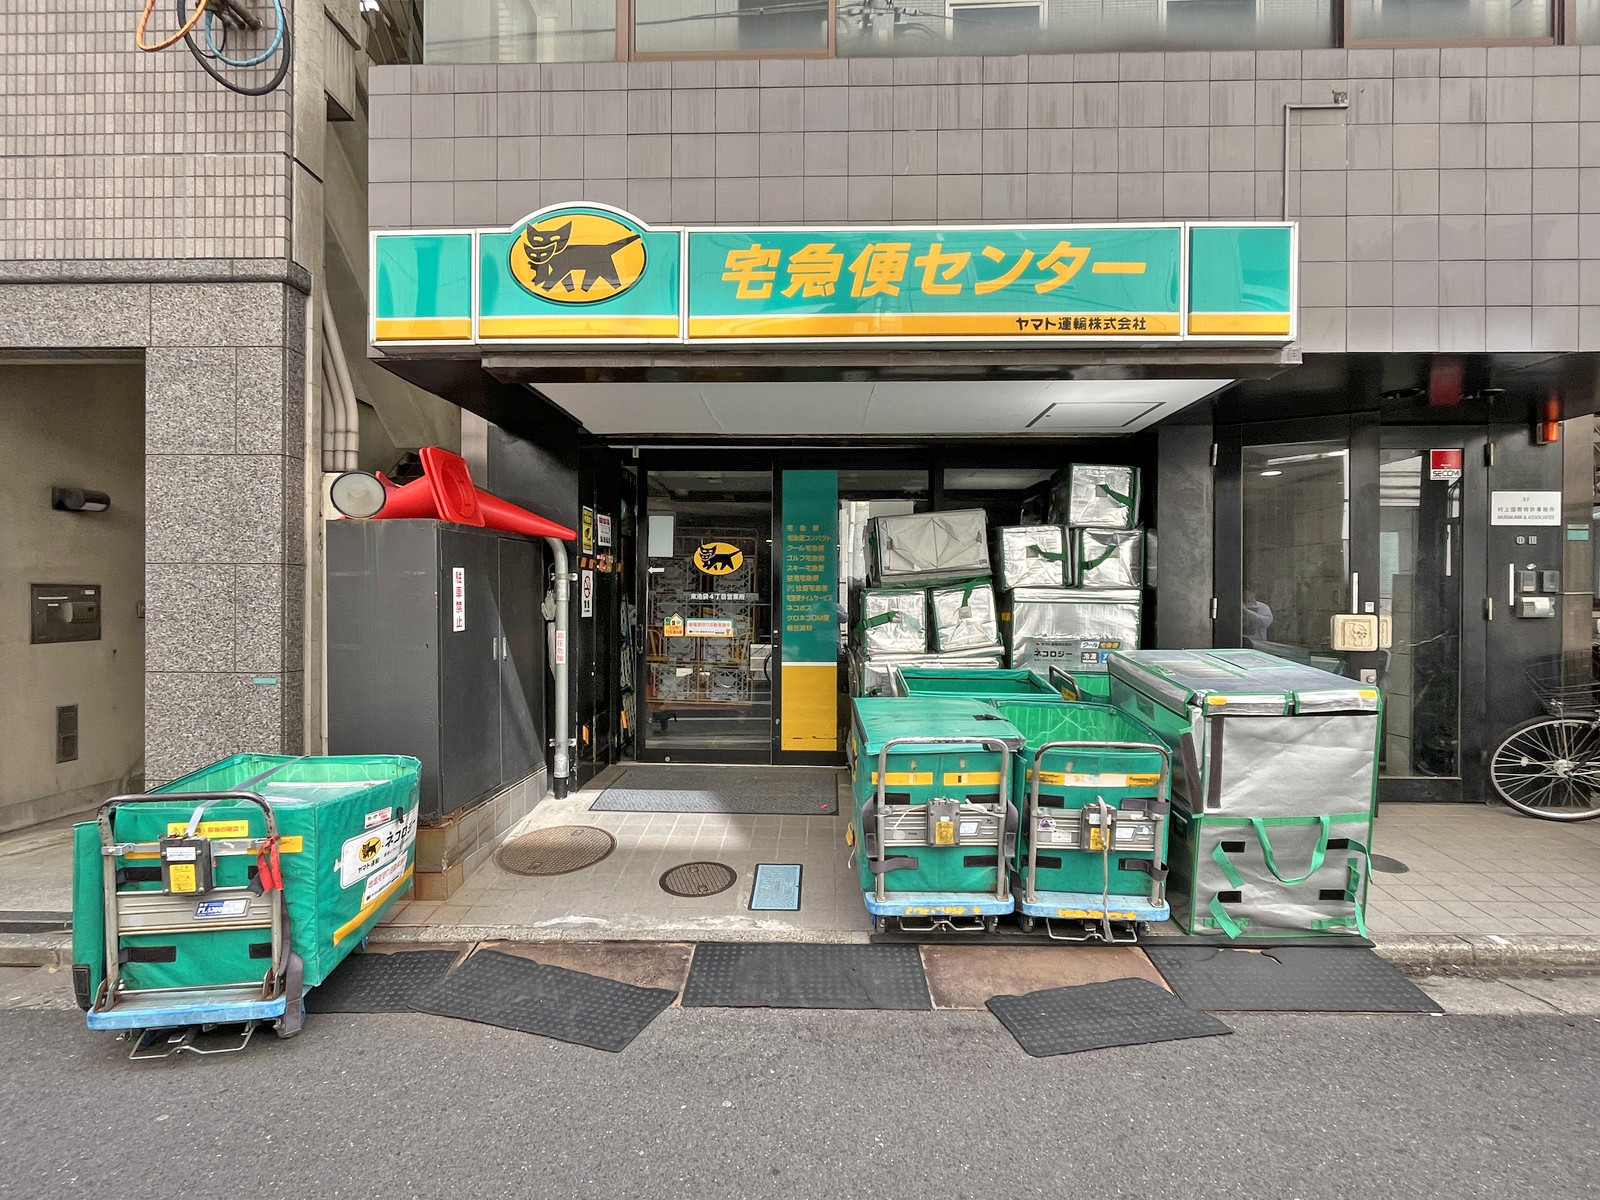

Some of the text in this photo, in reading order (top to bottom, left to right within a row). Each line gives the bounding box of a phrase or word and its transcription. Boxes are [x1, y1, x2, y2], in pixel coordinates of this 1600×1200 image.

[721, 241, 1147, 299] 宅急便センター
[1015, 316, 1147, 331] ヤマト運輸株式会社
[1432, 469, 1460, 477] SECOM
[455, 571, 463, 628] 駐車禁止
[1034, 648, 1072, 658] ネコロジー
